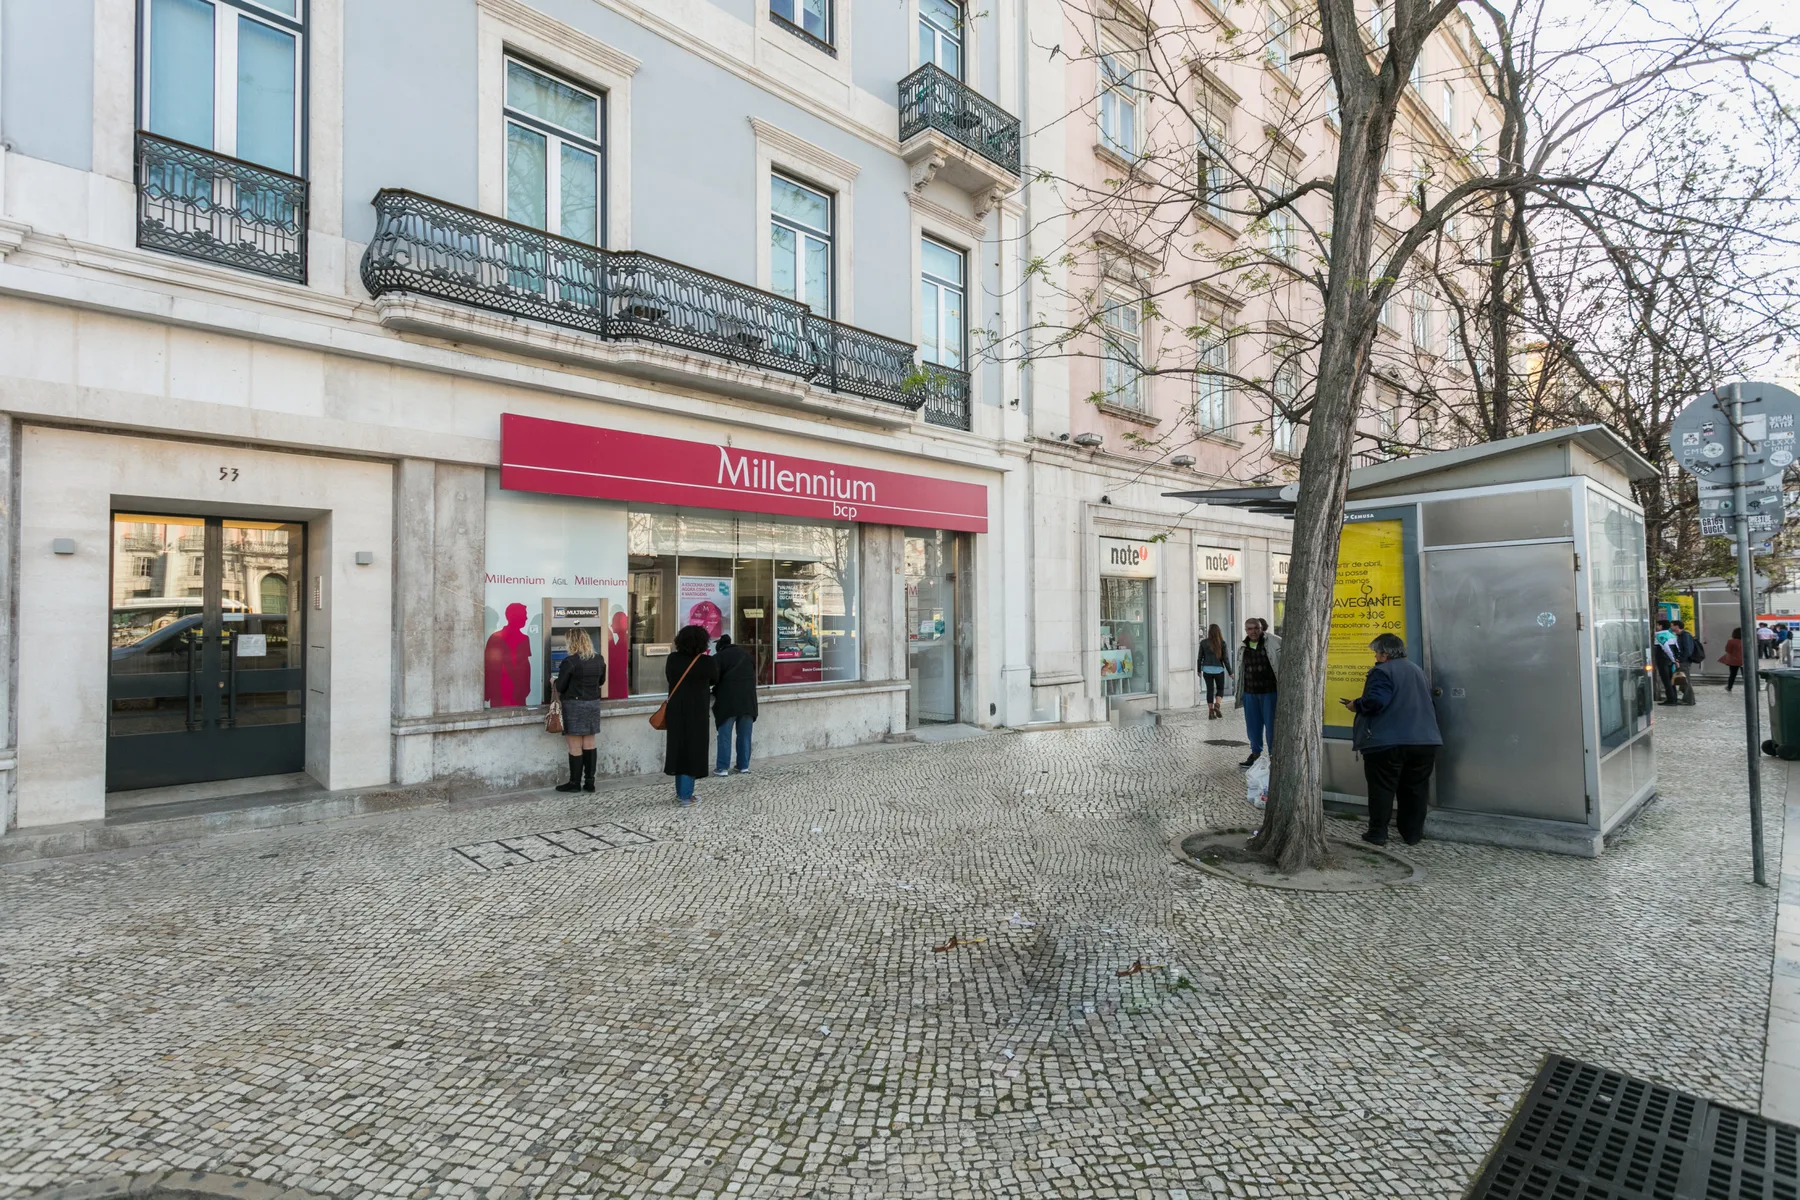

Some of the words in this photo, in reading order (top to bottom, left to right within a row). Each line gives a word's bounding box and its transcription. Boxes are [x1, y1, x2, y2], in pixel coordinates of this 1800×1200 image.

[219, 467, 239, 481] 53
[717, 445, 876, 502] Millennium
[833, 502, 857, 521] bcp
[485, 573, 545, 585] Millennium
[552, 577, 568, 585] ÁGIL
[574, 575, 627, 587] Millennium
[1333, 596, 1401, 608] AVEGANTE
[1381, 620, 1402, 629] 40€
